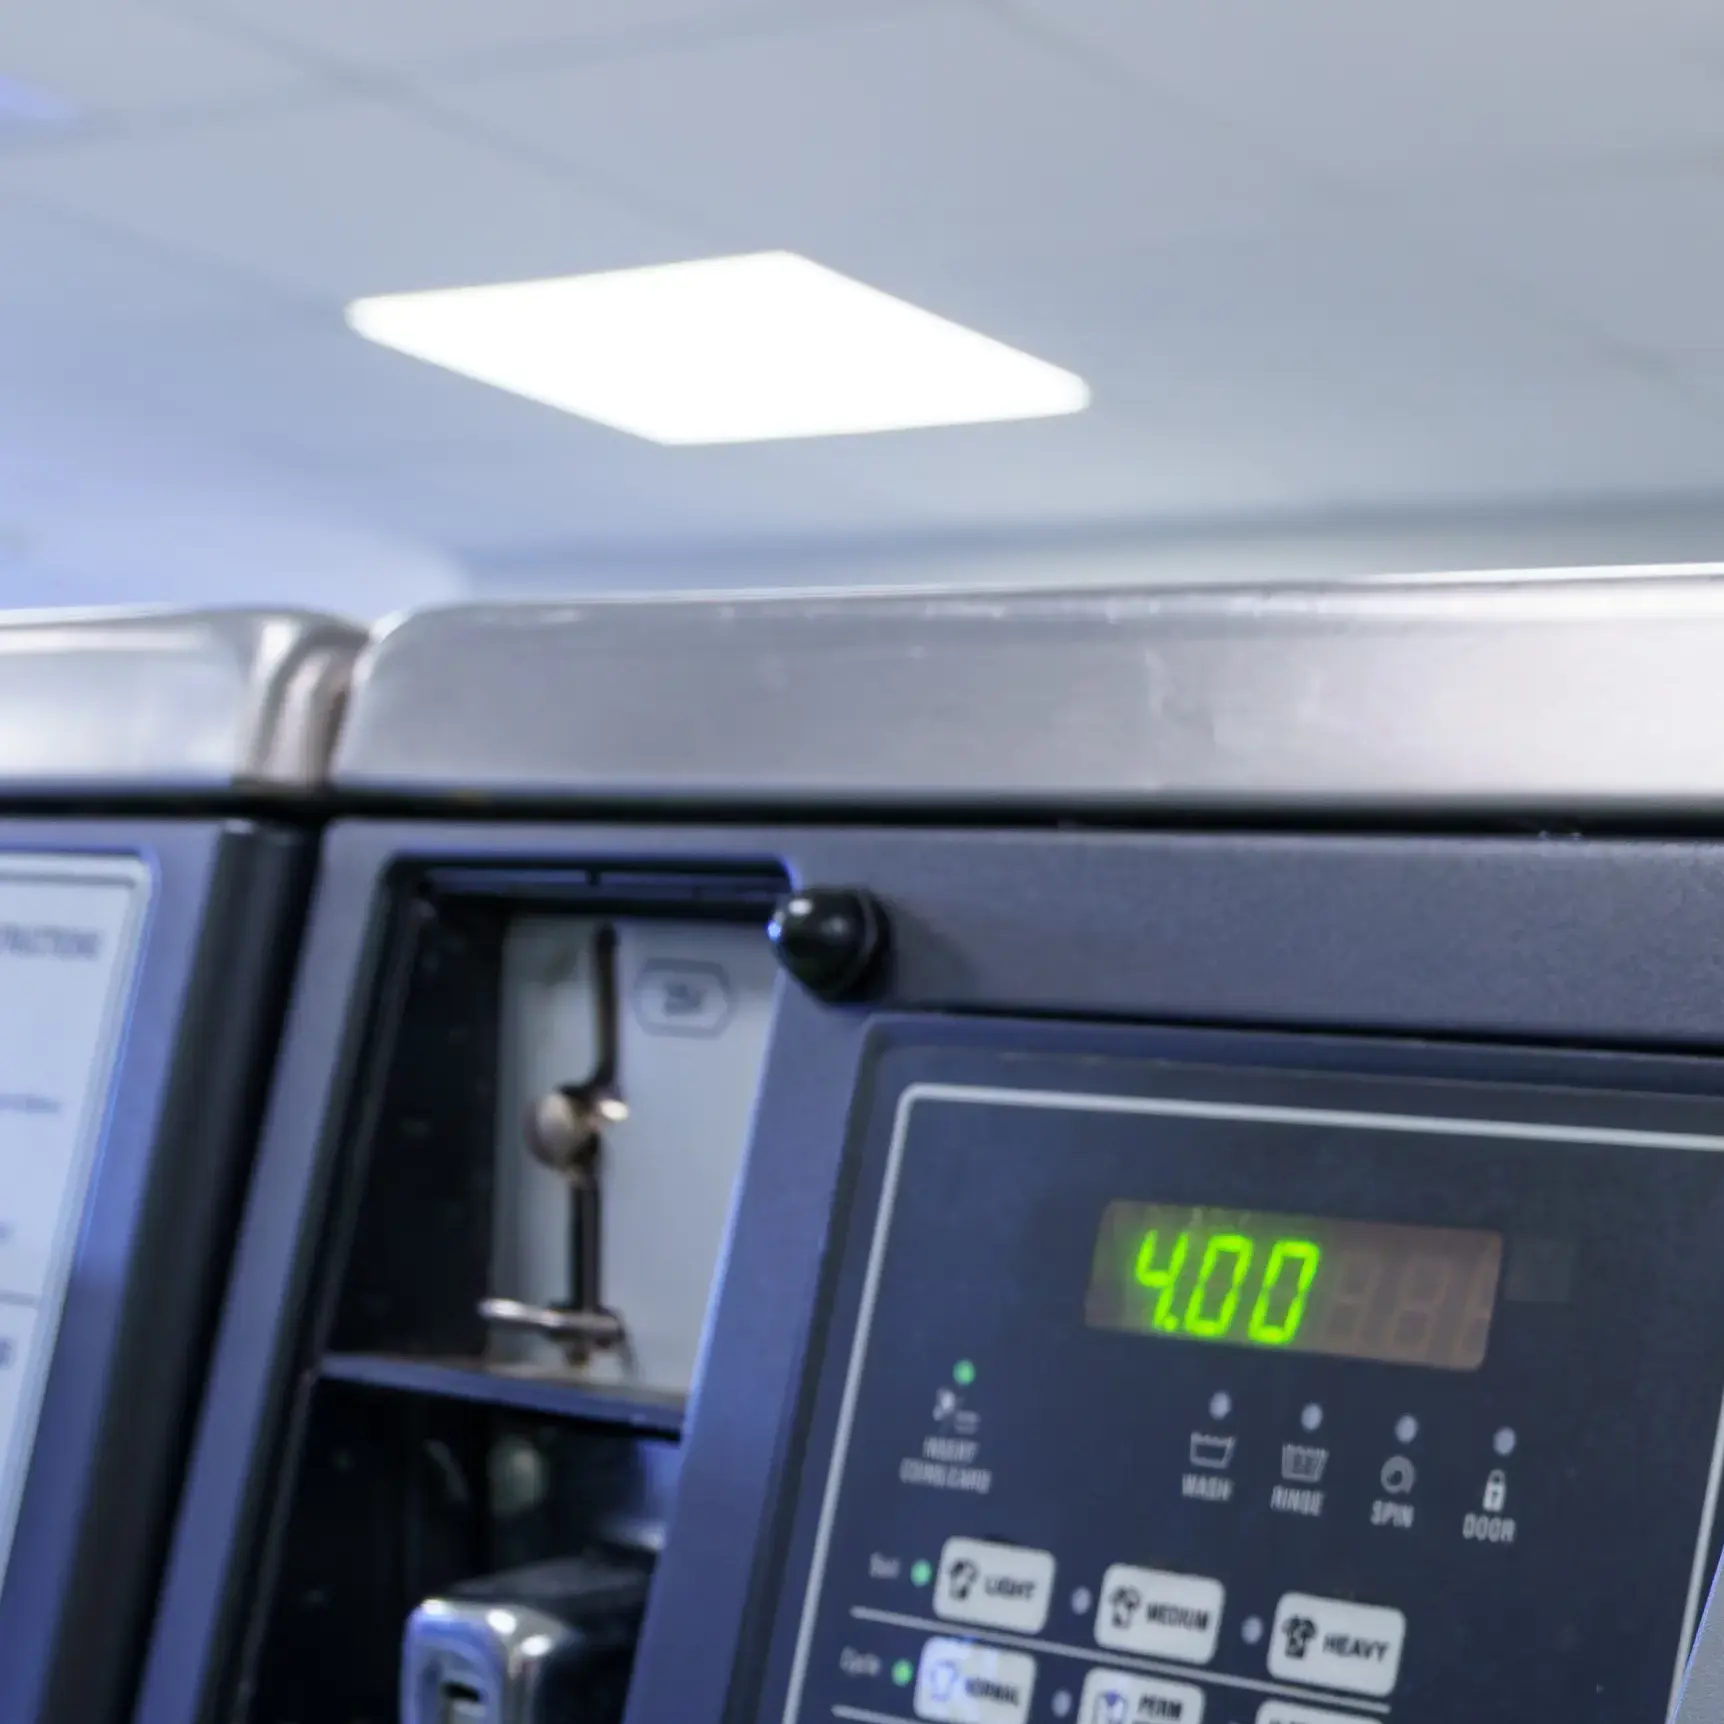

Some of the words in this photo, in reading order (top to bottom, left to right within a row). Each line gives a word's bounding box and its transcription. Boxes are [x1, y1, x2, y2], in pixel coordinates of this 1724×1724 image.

[1134, 1229, 1322, 1347] 4.00
[1370, 1500, 1415, 1528] SPIN
[1462, 1513, 1516, 1543] DOOR
[1147, 1603, 1210, 1631] MEDIUM
[1323, 1634, 1389, 1662] HEAVY
